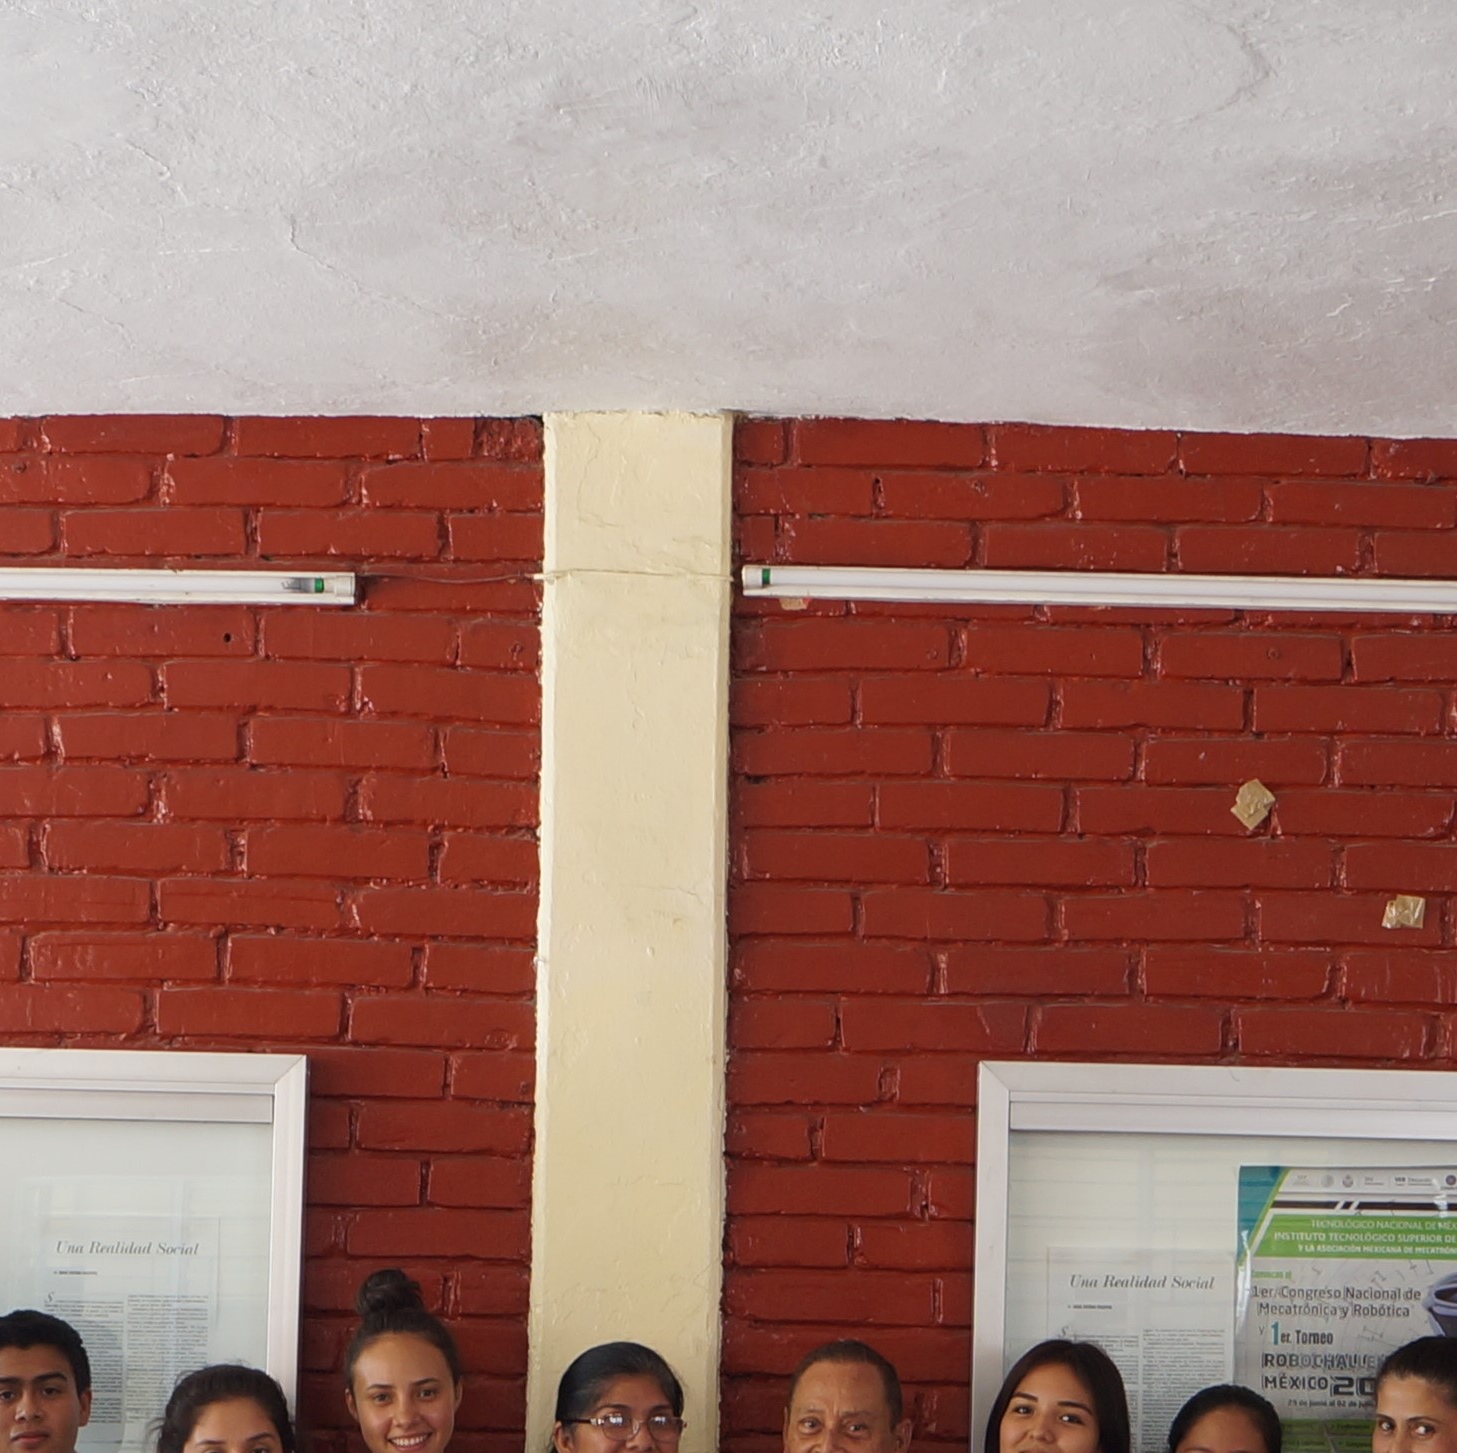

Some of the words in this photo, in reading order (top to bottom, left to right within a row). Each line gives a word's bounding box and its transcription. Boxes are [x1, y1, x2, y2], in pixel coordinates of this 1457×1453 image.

[1375, 1220, 1423, 1230] NACIONAL
[1424, 1221, 1436, 1231] DE
[1274, 1231, 1326, 1242] INSTITUTO
[1329, 1231, 1395, 1243] TECNOLÓGICO
[1398, 1234, 1442, 1243] SUPERIOR
[1444, 1234, 1456, 1244] DE
[56, 1240, 84, 1254] Una
[89, 1240, 153, 1254] Realidad
[155, 1242, 200, 1256] Social
[1069, 1274, 1098, 1289] Una
[1102, 1274, 1167, 1289] Realidad
[1171, 1275, 1216, 1290] Social
[1280, 1286, 1342, 1302] Congreso
[1345, 1287, 1402, 1301] Nacional
[1405, 1288, 1422, 1300] de
[1258, 1302, 1338, 1316] Mecatrónica
[1341, 1306, 1349, 1318] y
[1352, 1303, 1410, 1317] Robótica
[1295, 1329, 1334, 1345] Torneo
[1262, 1374, 1329, 1390] MÉXICO
